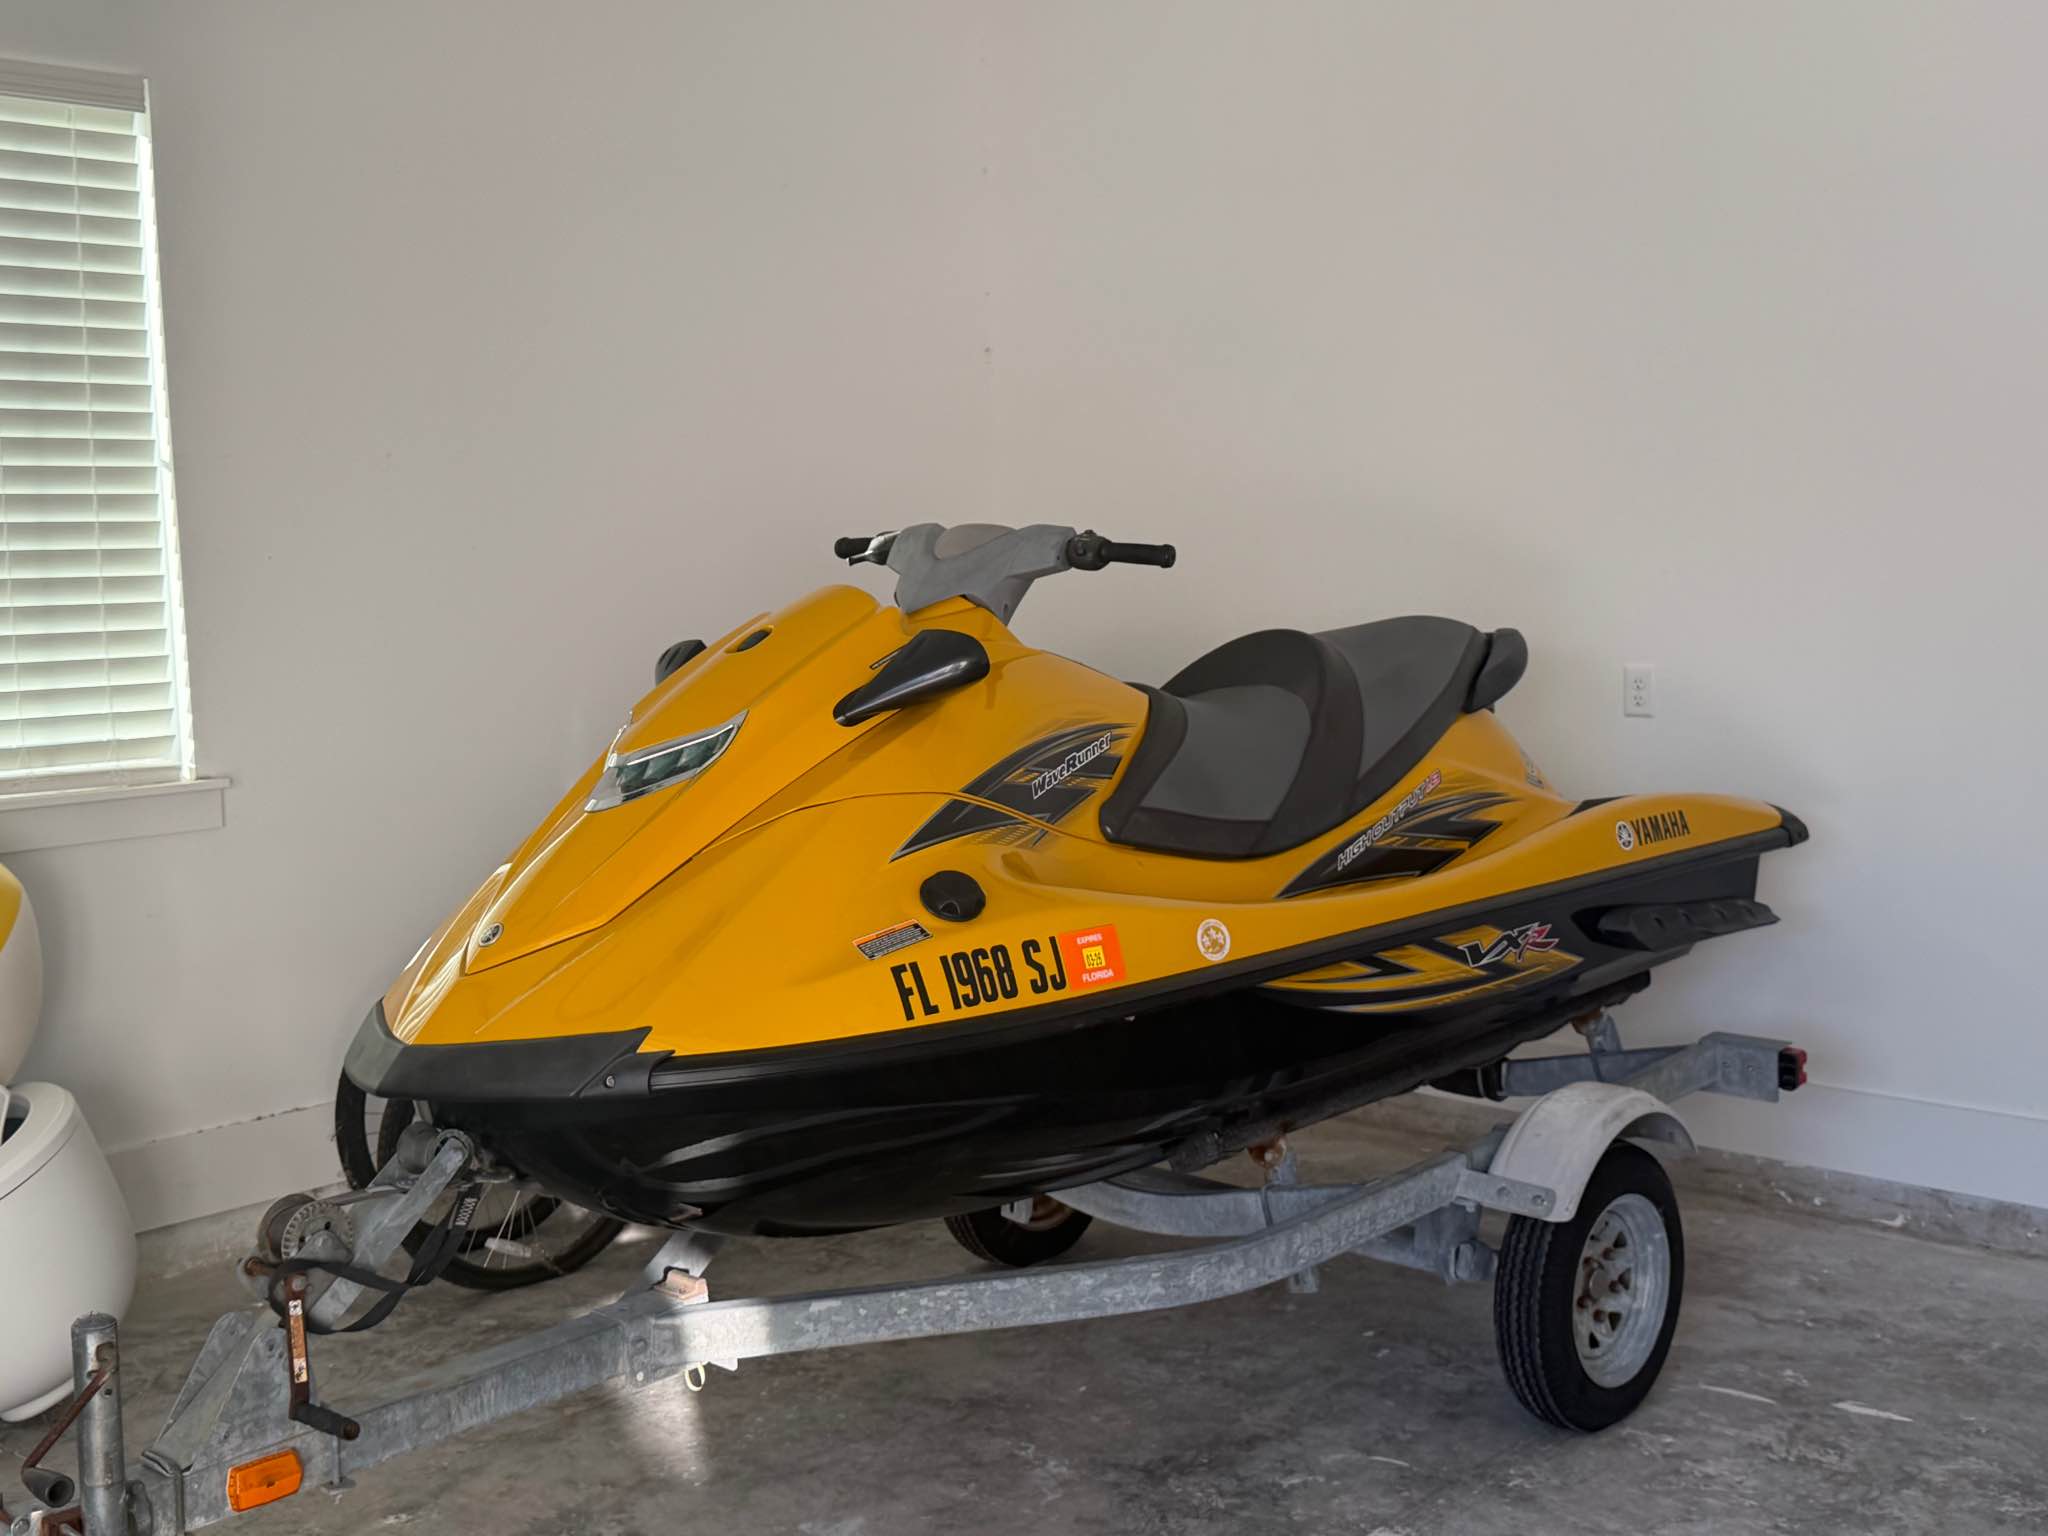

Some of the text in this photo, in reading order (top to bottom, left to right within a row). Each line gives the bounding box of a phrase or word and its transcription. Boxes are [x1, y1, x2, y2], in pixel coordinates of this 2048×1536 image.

[1032, 731, 1112, 800] WaveRunner
[1337, 828, 1372, 871] HIGH
[1371, 783, 1425, 840] OUTPUT
[1630, 809, 1691, 847] YAMAHA
[1076, 933, 1103, 945] EXPIRES
[1457, 921, 1560, 968] VXR
[890, 935, 1067, 1021] FL 1968 SJ
[1082, 969, 1114, 984] FLORIDA
